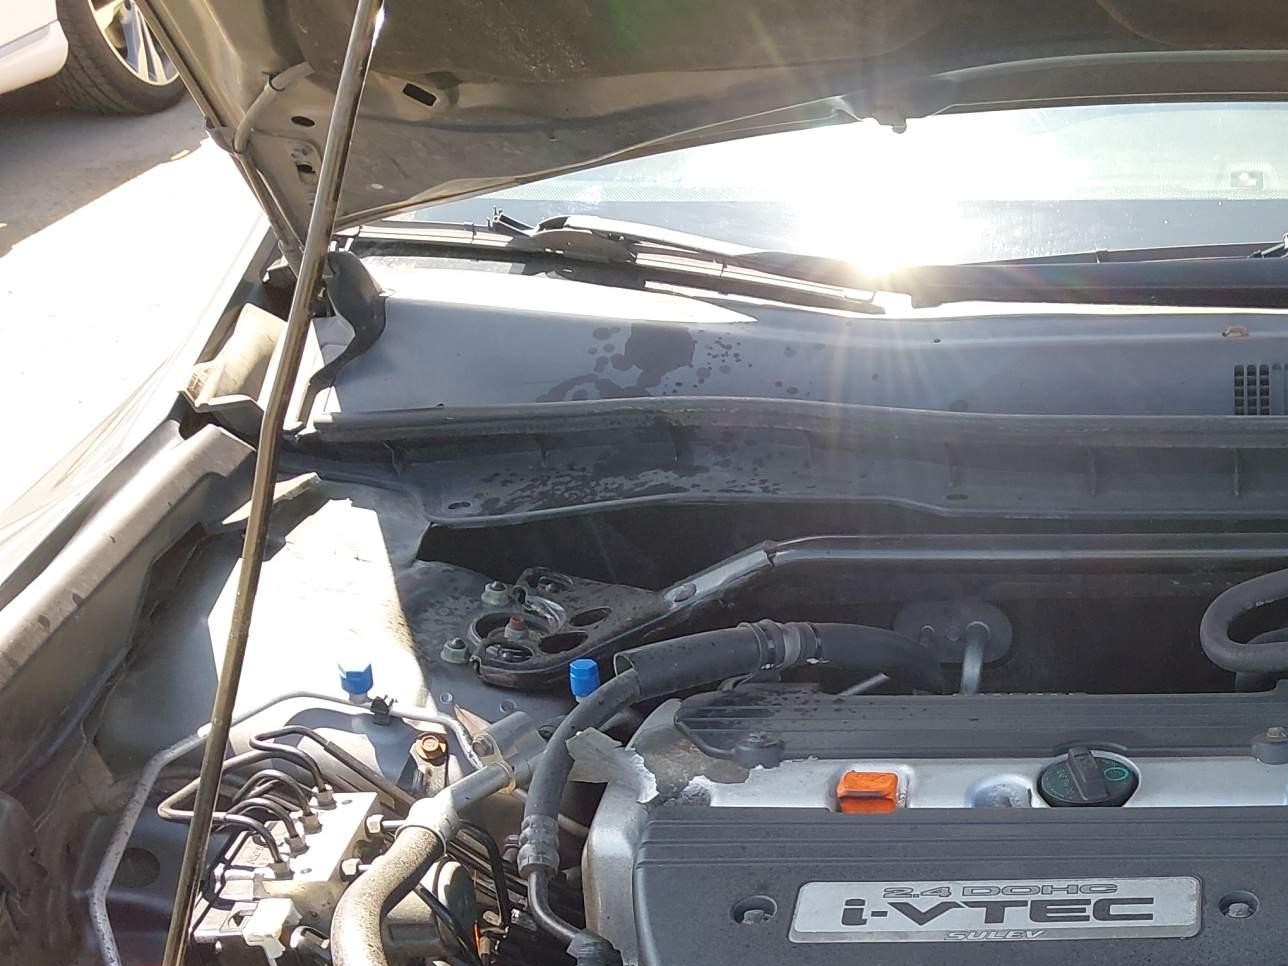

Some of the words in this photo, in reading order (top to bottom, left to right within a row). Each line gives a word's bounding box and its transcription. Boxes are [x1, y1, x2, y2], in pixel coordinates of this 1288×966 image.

[883, 885, 952, 899] 2.4
[961, 882, 1119, 897] DOHC
[840, 897, 1154, 927] i-VTEC
[943, 929, 1047, 941] SULEV
